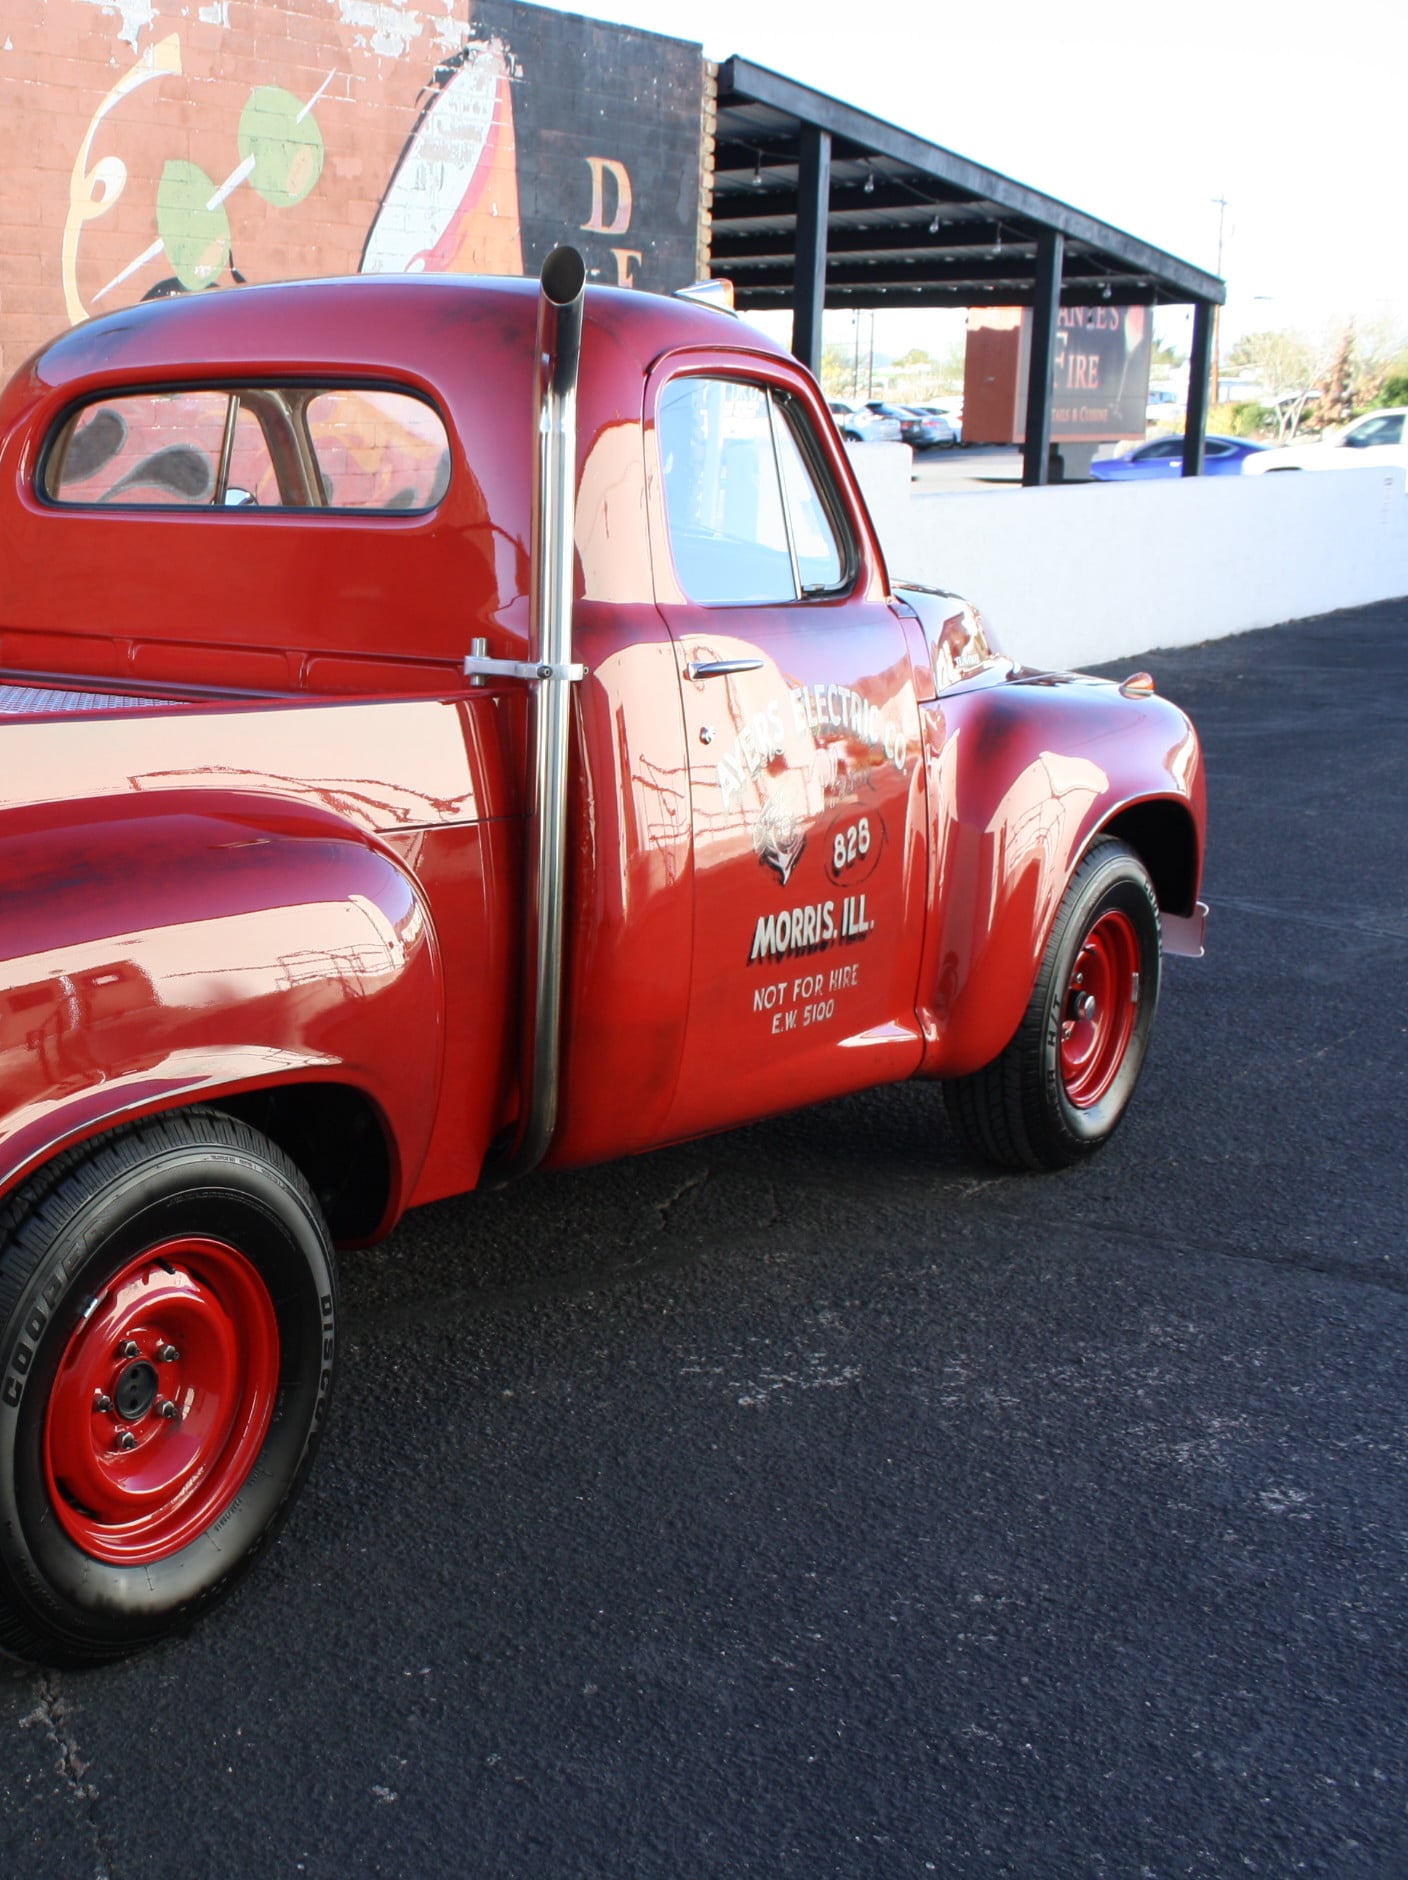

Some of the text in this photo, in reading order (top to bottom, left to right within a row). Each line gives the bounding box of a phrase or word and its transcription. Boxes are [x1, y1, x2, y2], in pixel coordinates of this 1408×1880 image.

[789, 684, 881, 744] ELECTRIC
[753, 963, 859, 1011] NOT FOR HIRE
[803, 998, 835, 1026] 5100
